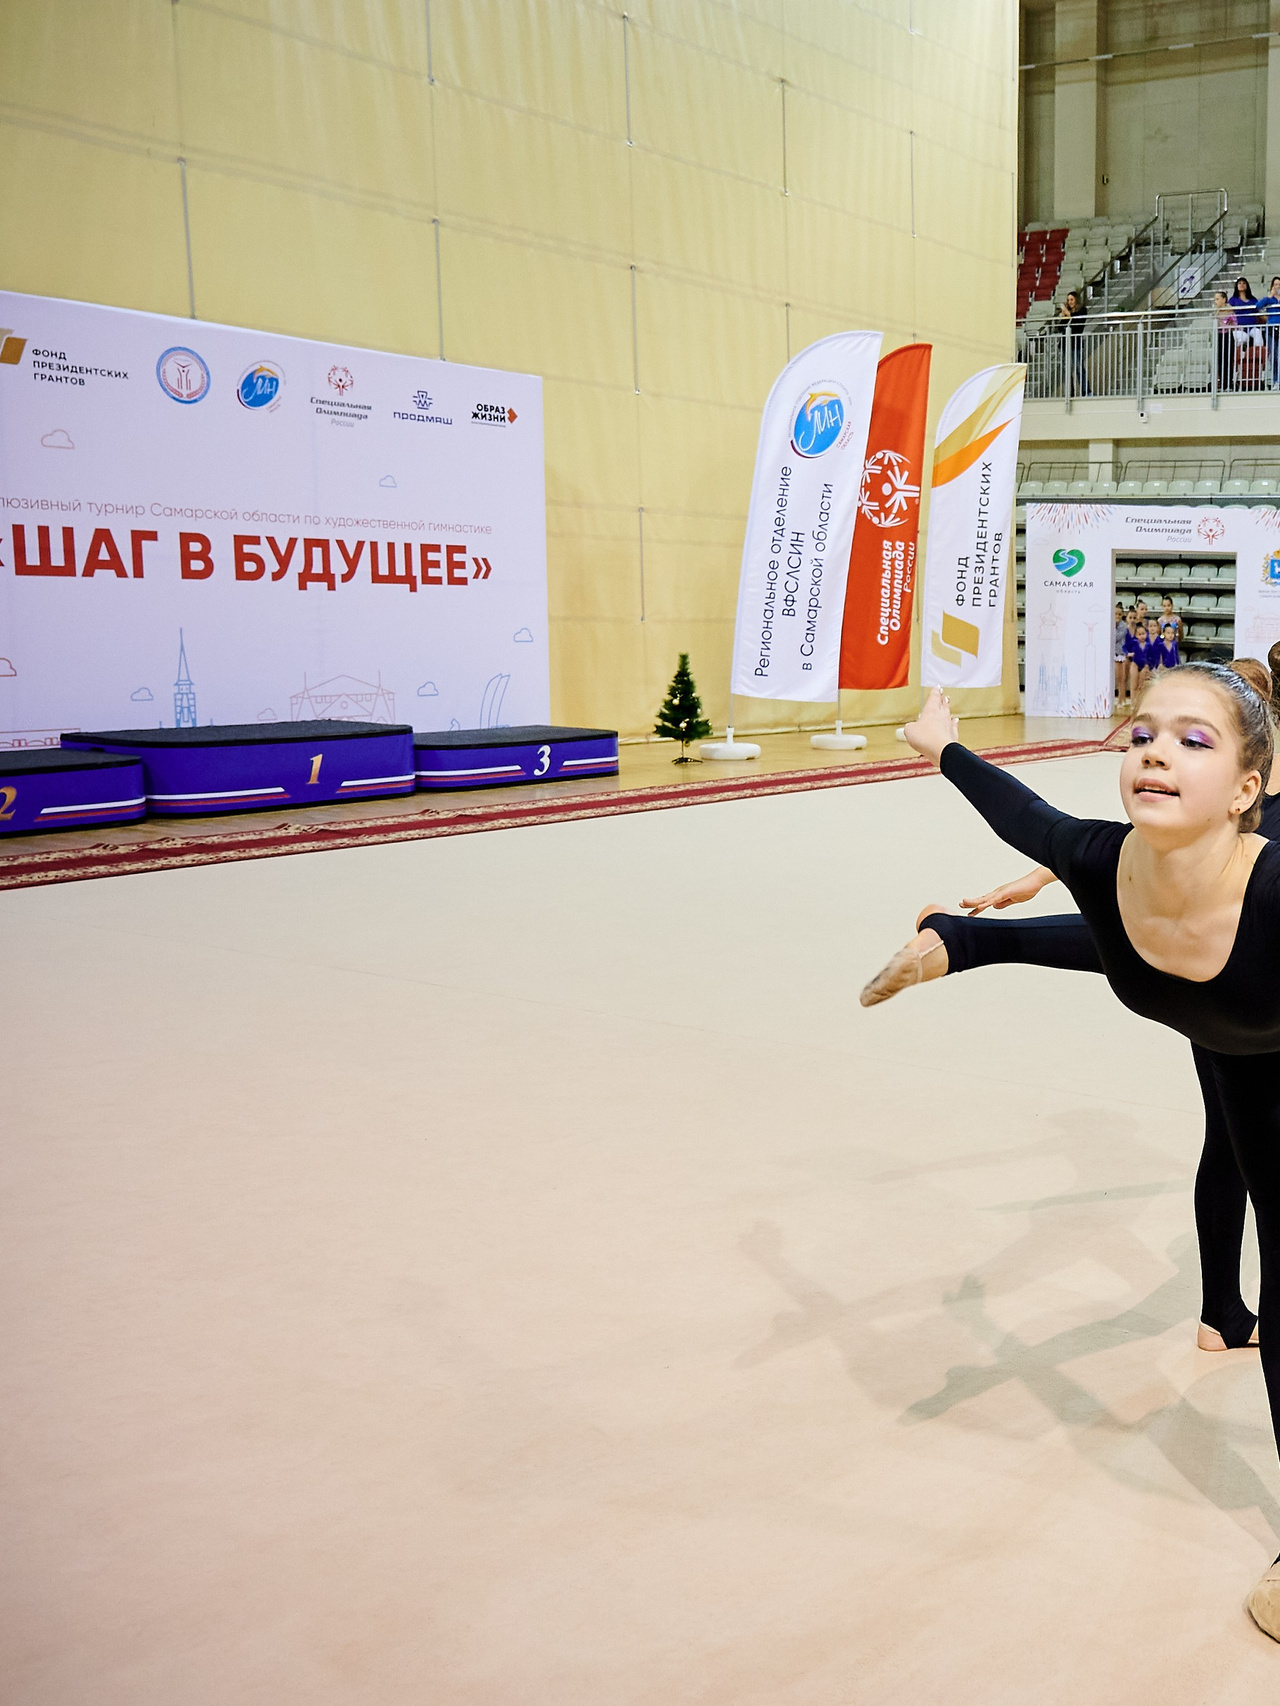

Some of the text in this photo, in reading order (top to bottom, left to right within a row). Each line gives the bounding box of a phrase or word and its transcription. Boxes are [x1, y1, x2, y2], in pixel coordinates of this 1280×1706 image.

[32, 348, 67, 361] ФОНД
[33, 360, 129, 379] ПРЕЗИДЕНТСКИХ
[33, 373, 85, 386] ГРАНТОВ
[471, 411, 506, 423] ЖИЗНИ
[476, 403, 506, 415] ОБРАЗ
[87, 500, 146, 517] турнир
[150, 502, 238, 521] Самарской
[242, 509, 300, 525] области
[304, 514, 321, 526] по
[324, 516, 425, 532] художественной
[428, 522, 492, 535] гимнастике
[972, 461, 992, 607] ПРЕЗИДЕНТСКИХ
[0, 524, 492, 593] ШАГ В БУДУЩЕЕ»
[755, 466, 792, 677] Региональное отделение
[782, 531, 805, 617] ВФСЛСИН
[800, 483, 834, 671] в Самарской области
[903, 542, 915, 593] России
[989, 532, 1003, 608] ГРАНТОВ
[877, 540, 893, 645] Специальная
[889, 541, 905, 631] Олимпиада
[955, 556, 970, 607] ФОНД
[1043, 580, 1094, 588] САМАРСКАЯ
[306, 753, 323, 785] 1
[533, 744, 551, 776] 3
[0, 785, 17, 821] 2
